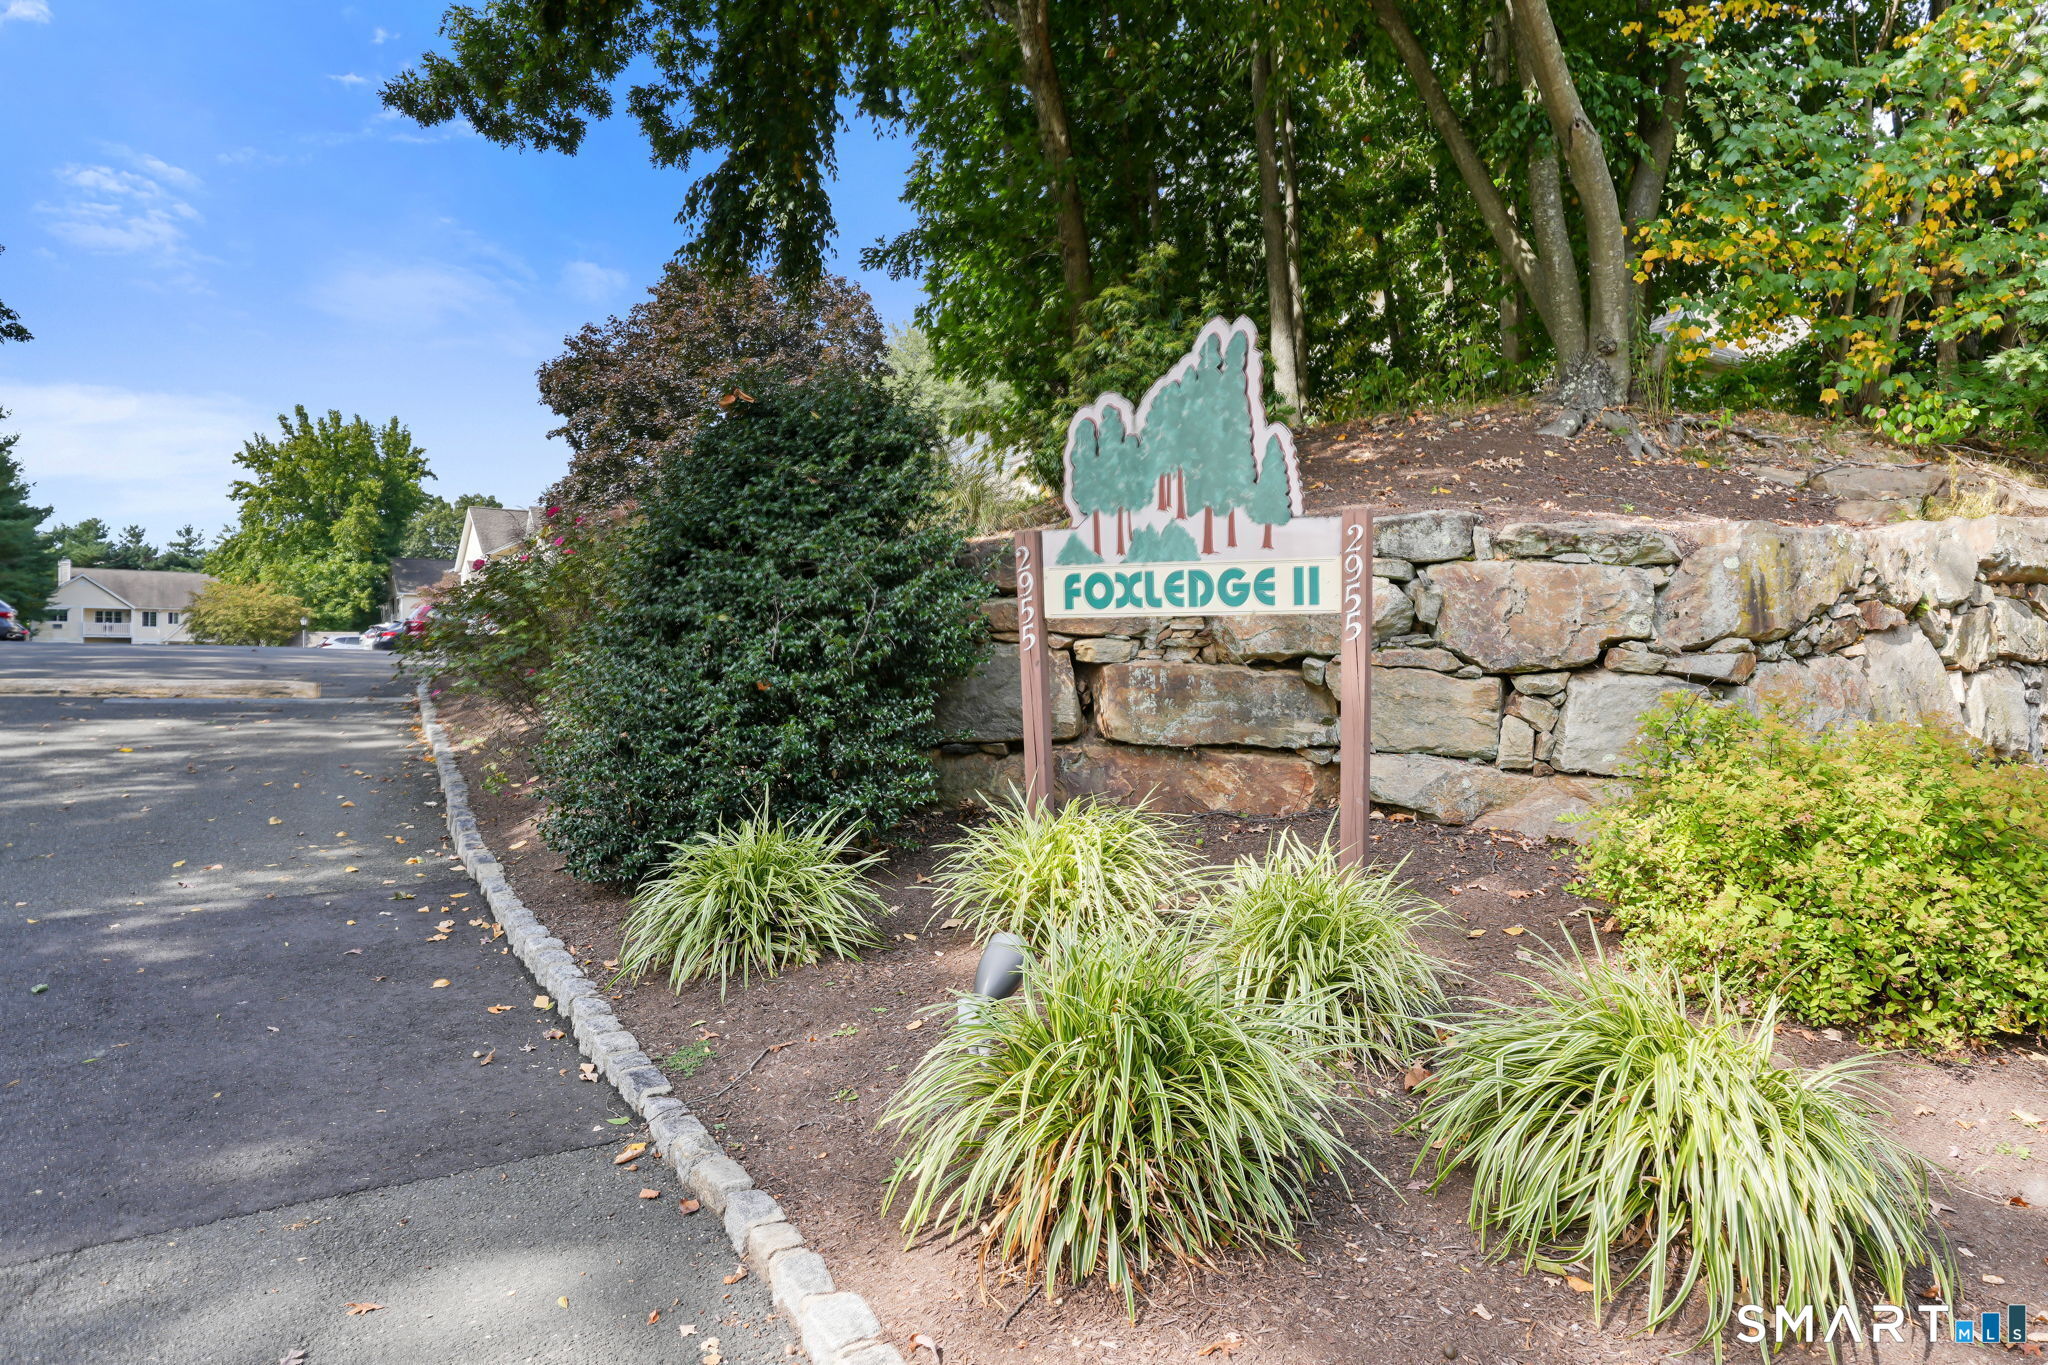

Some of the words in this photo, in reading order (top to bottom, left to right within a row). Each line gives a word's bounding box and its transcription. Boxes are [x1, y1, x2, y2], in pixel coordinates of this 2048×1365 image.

[1014, 546, 1036, 651] 2955
[1063, 567, 1276, 610] FOXLEDGE
[1293, 565, 1321, 606] II
[1343, 523, 1365, 642] 2955
